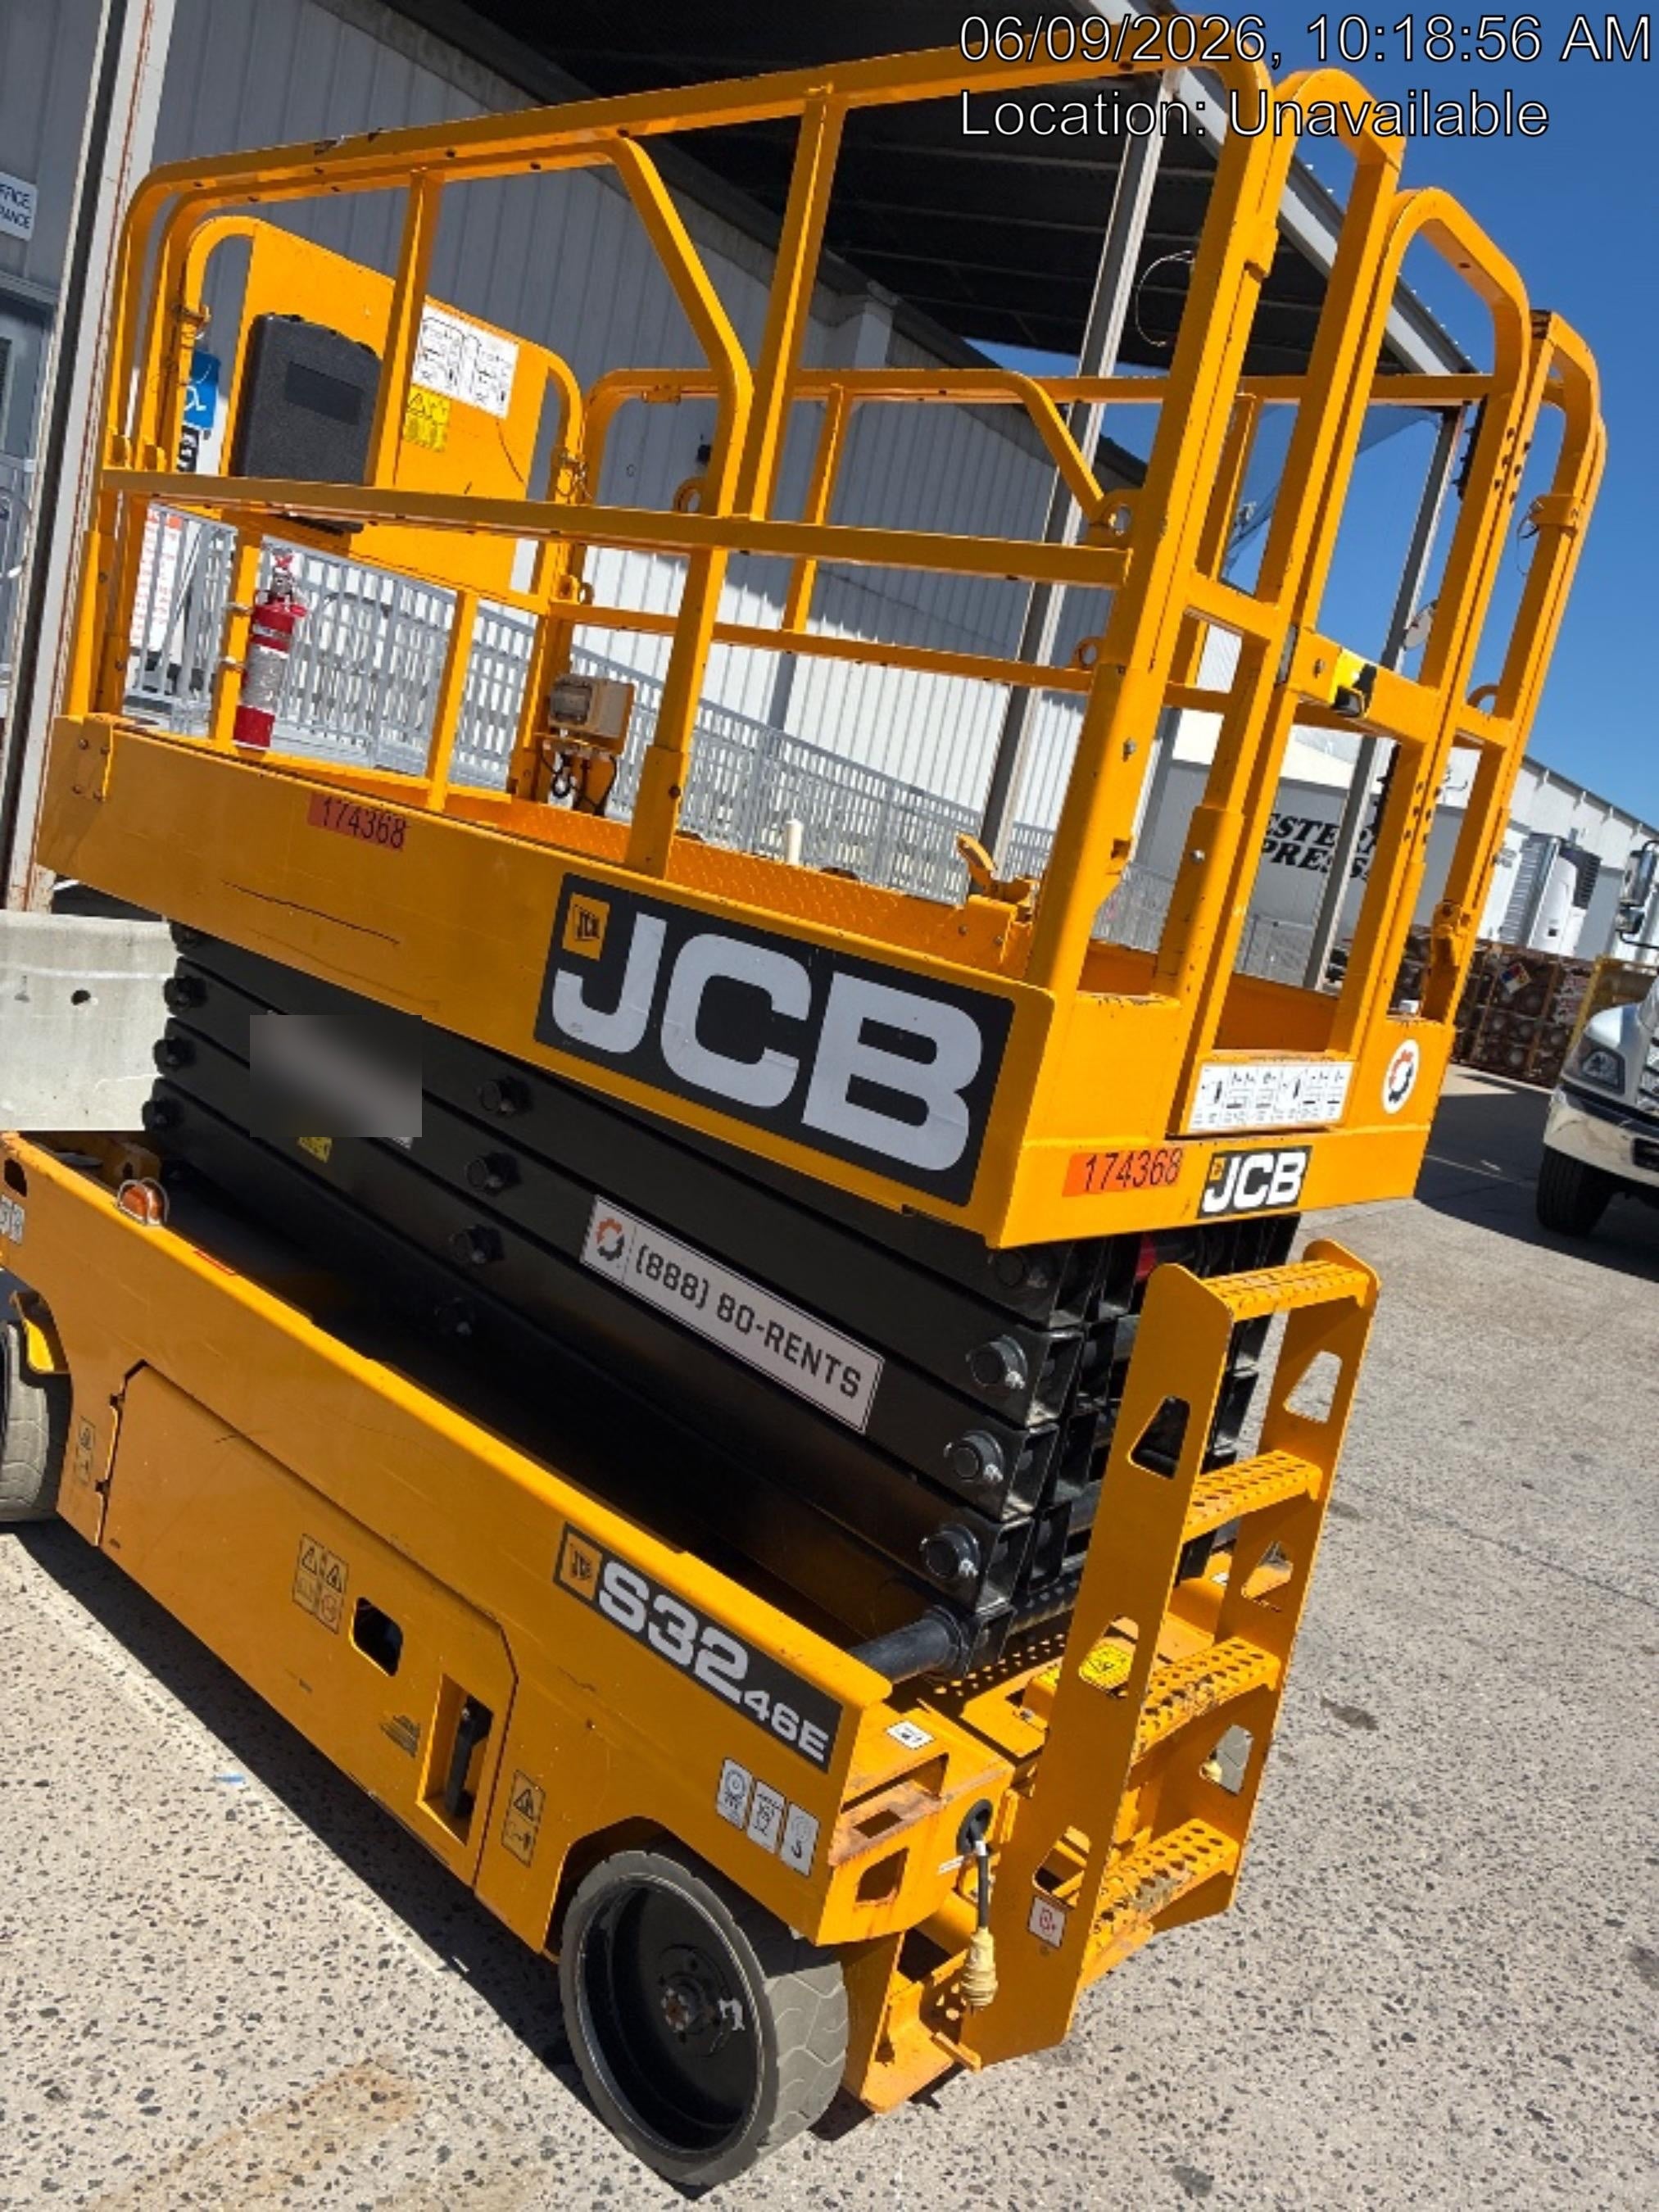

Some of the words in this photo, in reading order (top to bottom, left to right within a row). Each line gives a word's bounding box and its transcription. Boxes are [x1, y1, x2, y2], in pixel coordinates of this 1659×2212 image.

[323, 796, 407, 849] 174368
[552, 911, 982, 1172] JCB
[1086, 1147, 1183, 1192] 174368
[1202, 1151, 1306, 1213] JCB
[635, 1244, 710, 1311] (888)
[716, 1292, 863, 1399] 80-RENTS
